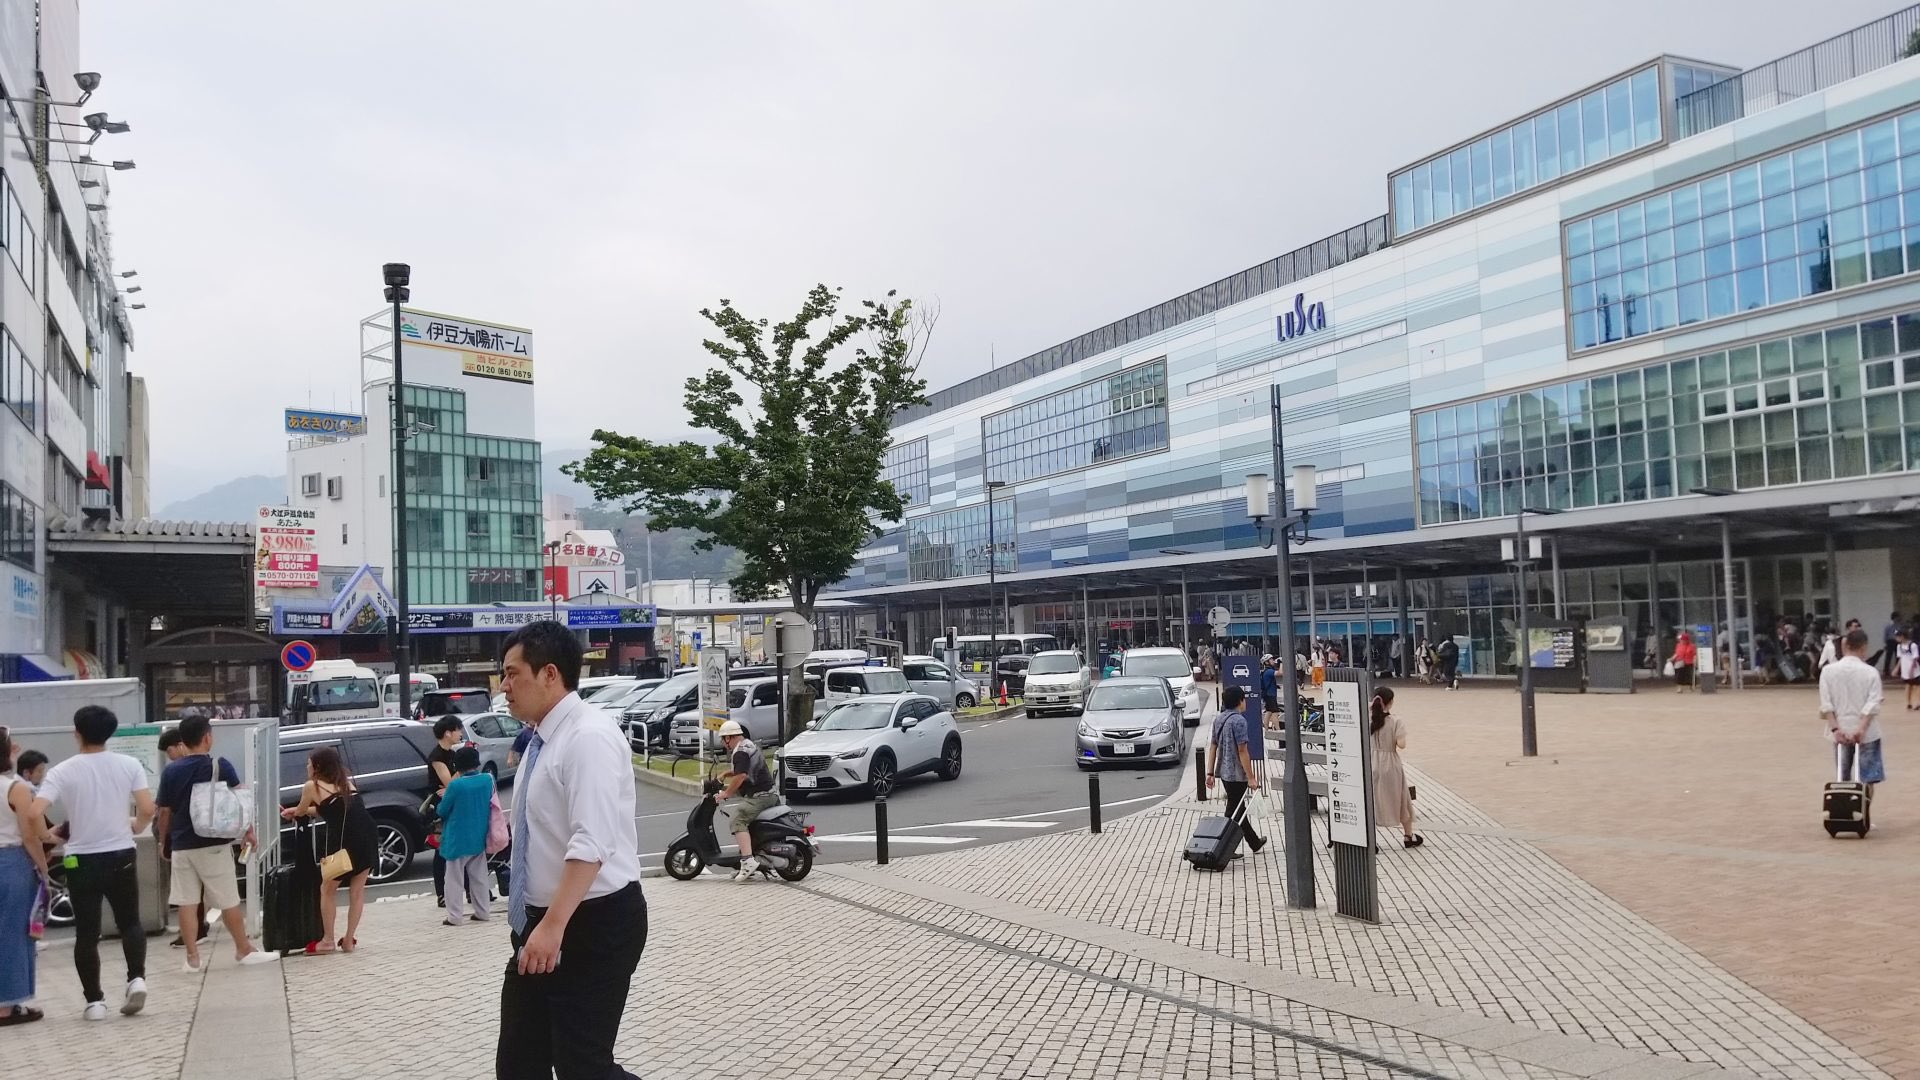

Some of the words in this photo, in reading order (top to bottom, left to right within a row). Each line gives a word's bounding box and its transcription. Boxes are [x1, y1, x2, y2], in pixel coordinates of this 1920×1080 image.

[1277, 293, 1326, 342] LUSCA
[427, 322, 527, 355] 伊豆太陽ホーム
[476, 365, 495, 374] 0120
[276, 518, 302, 527] あたみ
[468, 569, 511, 583] テナント
